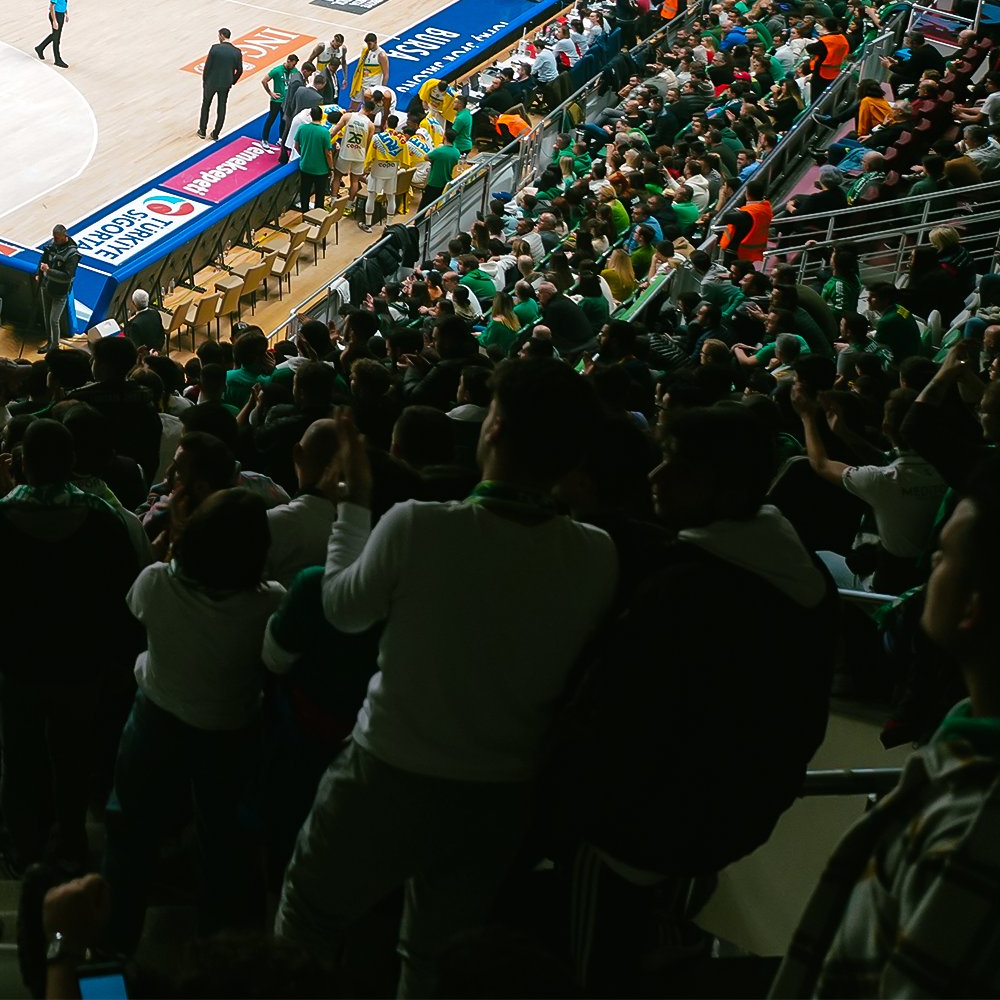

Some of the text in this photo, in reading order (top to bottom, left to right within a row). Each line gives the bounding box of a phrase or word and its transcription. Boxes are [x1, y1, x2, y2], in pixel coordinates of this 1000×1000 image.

[234, 27, 300, 60] ING
[386, 27, 460, 62] BURSA
[347, 132, 362, 144] 26
[183, 141, 280, 196] Yemeksepeti
